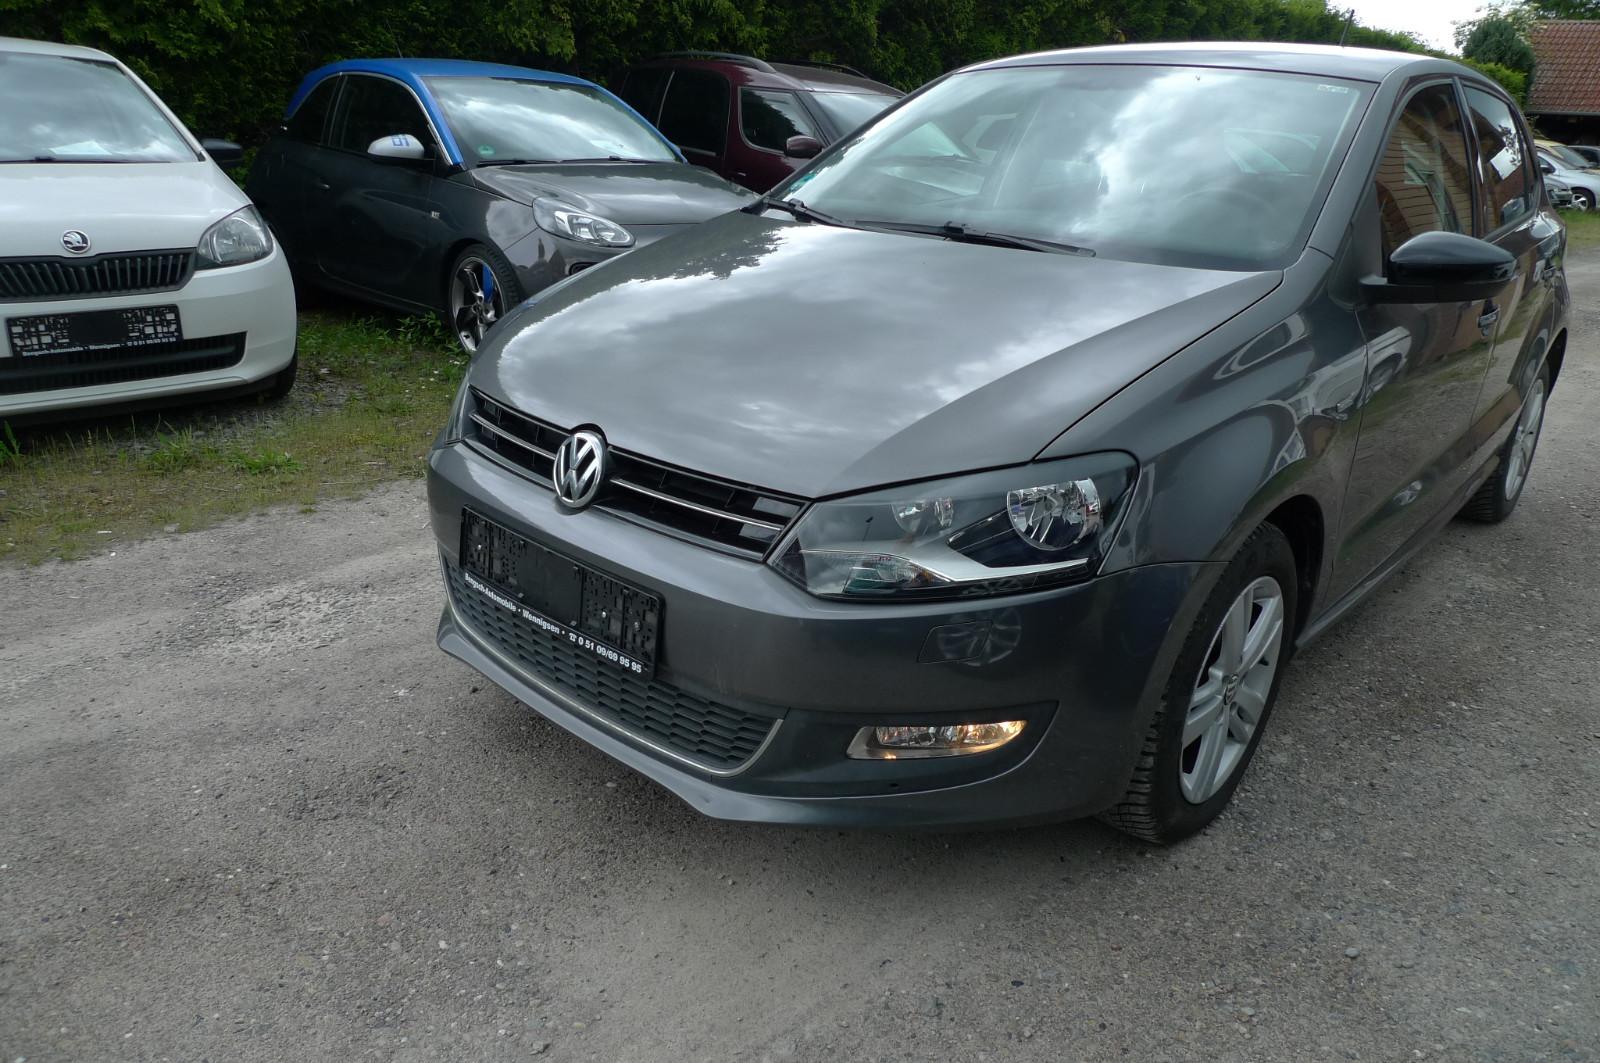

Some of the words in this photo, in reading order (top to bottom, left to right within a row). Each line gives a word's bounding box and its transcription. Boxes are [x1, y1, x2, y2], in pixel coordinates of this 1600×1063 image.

[522, 608, 560, 635] Wennigsen
[578, 636, 584, 646] 0
[585, 640, 595, 650] 51
[596, 645, 618, 662] 09/69
[619, 656, 630, 668] 95
[631, 662, 642, 673] 95
